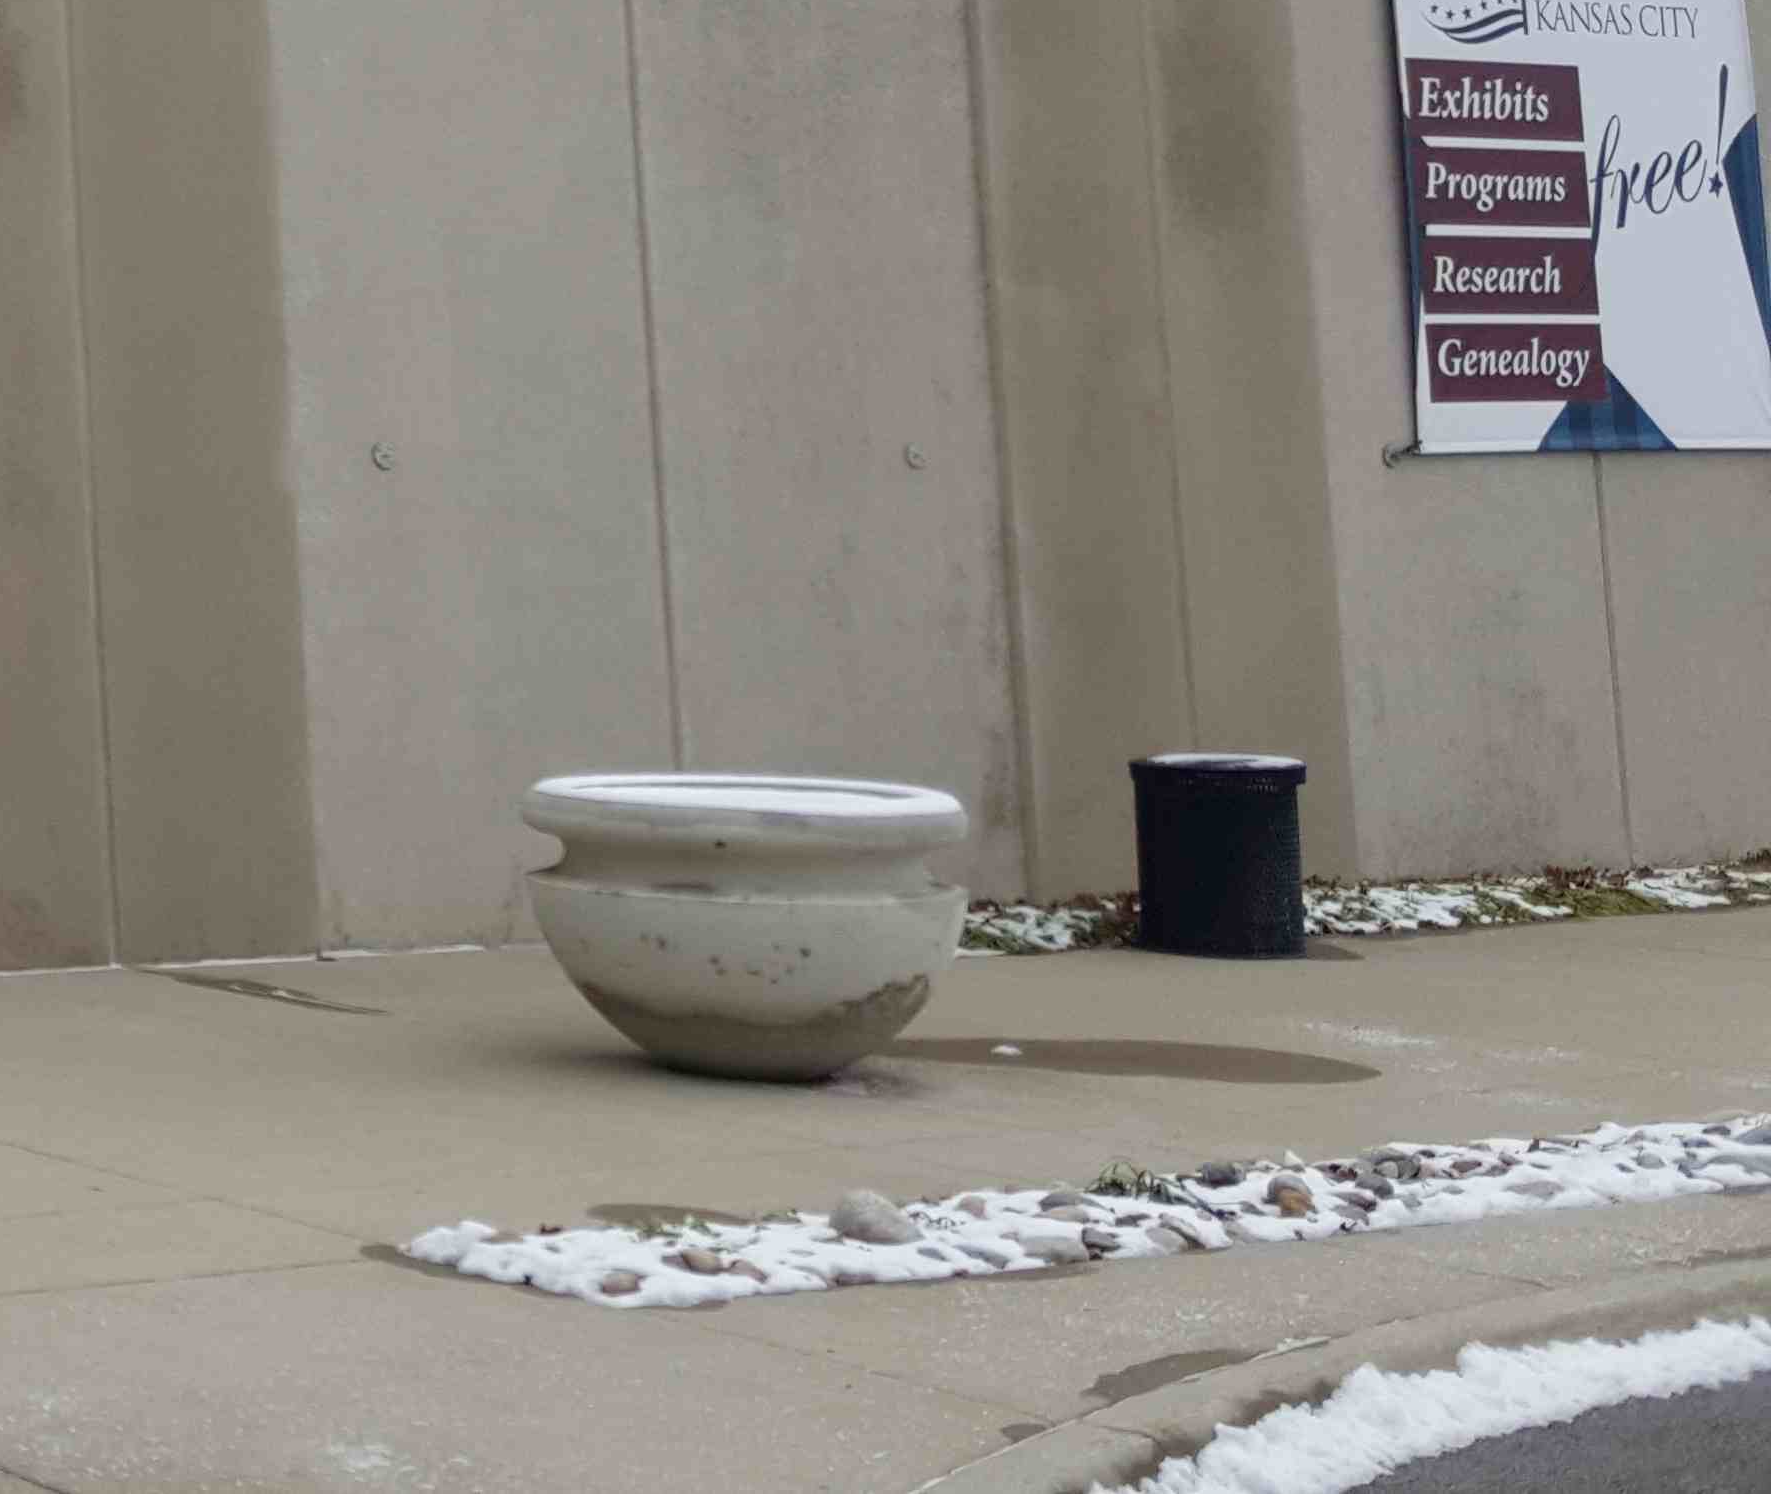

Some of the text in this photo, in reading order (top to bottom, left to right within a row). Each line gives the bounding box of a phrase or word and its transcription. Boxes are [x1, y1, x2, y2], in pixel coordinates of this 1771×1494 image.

[1638, 4, 1699, 39] CITY
[1418, 76, 1550, 123] Exhibits
[1425, 161, 1567, 213] Programs
[1433, 255, 1562, 295] Research
[1437, 337, 1591, 387] Genealogy
